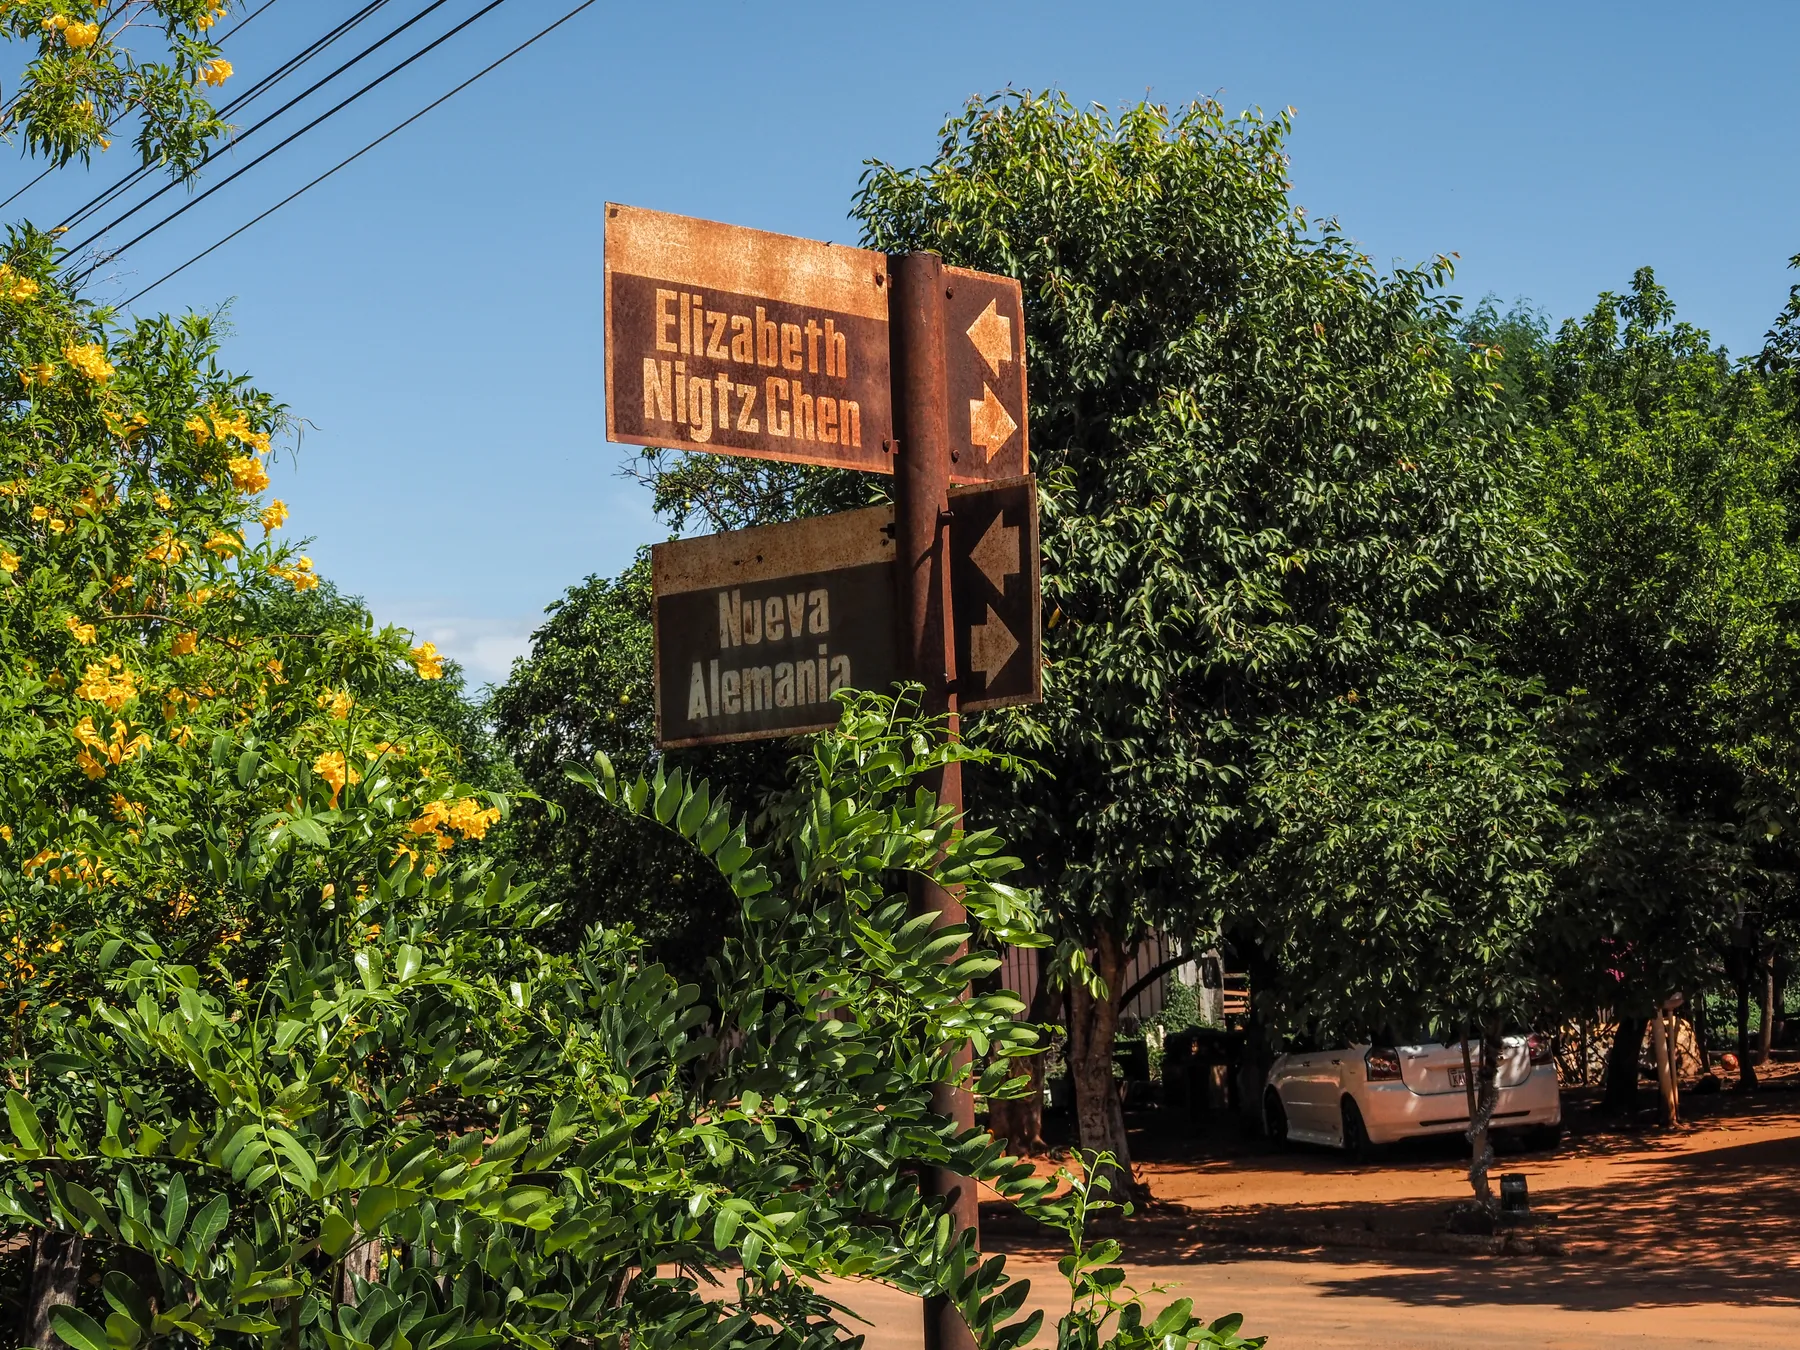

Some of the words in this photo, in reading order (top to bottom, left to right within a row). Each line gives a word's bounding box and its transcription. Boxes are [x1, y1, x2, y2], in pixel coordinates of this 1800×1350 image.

[656, 288, 848, 378] Elizabeth
[643, 357, 760, 443] Nigtz
[765, 376, 862, 448] Chen
[718, 588, 830, 649] Nueva
[687, 643, 851, 721] Alemania
